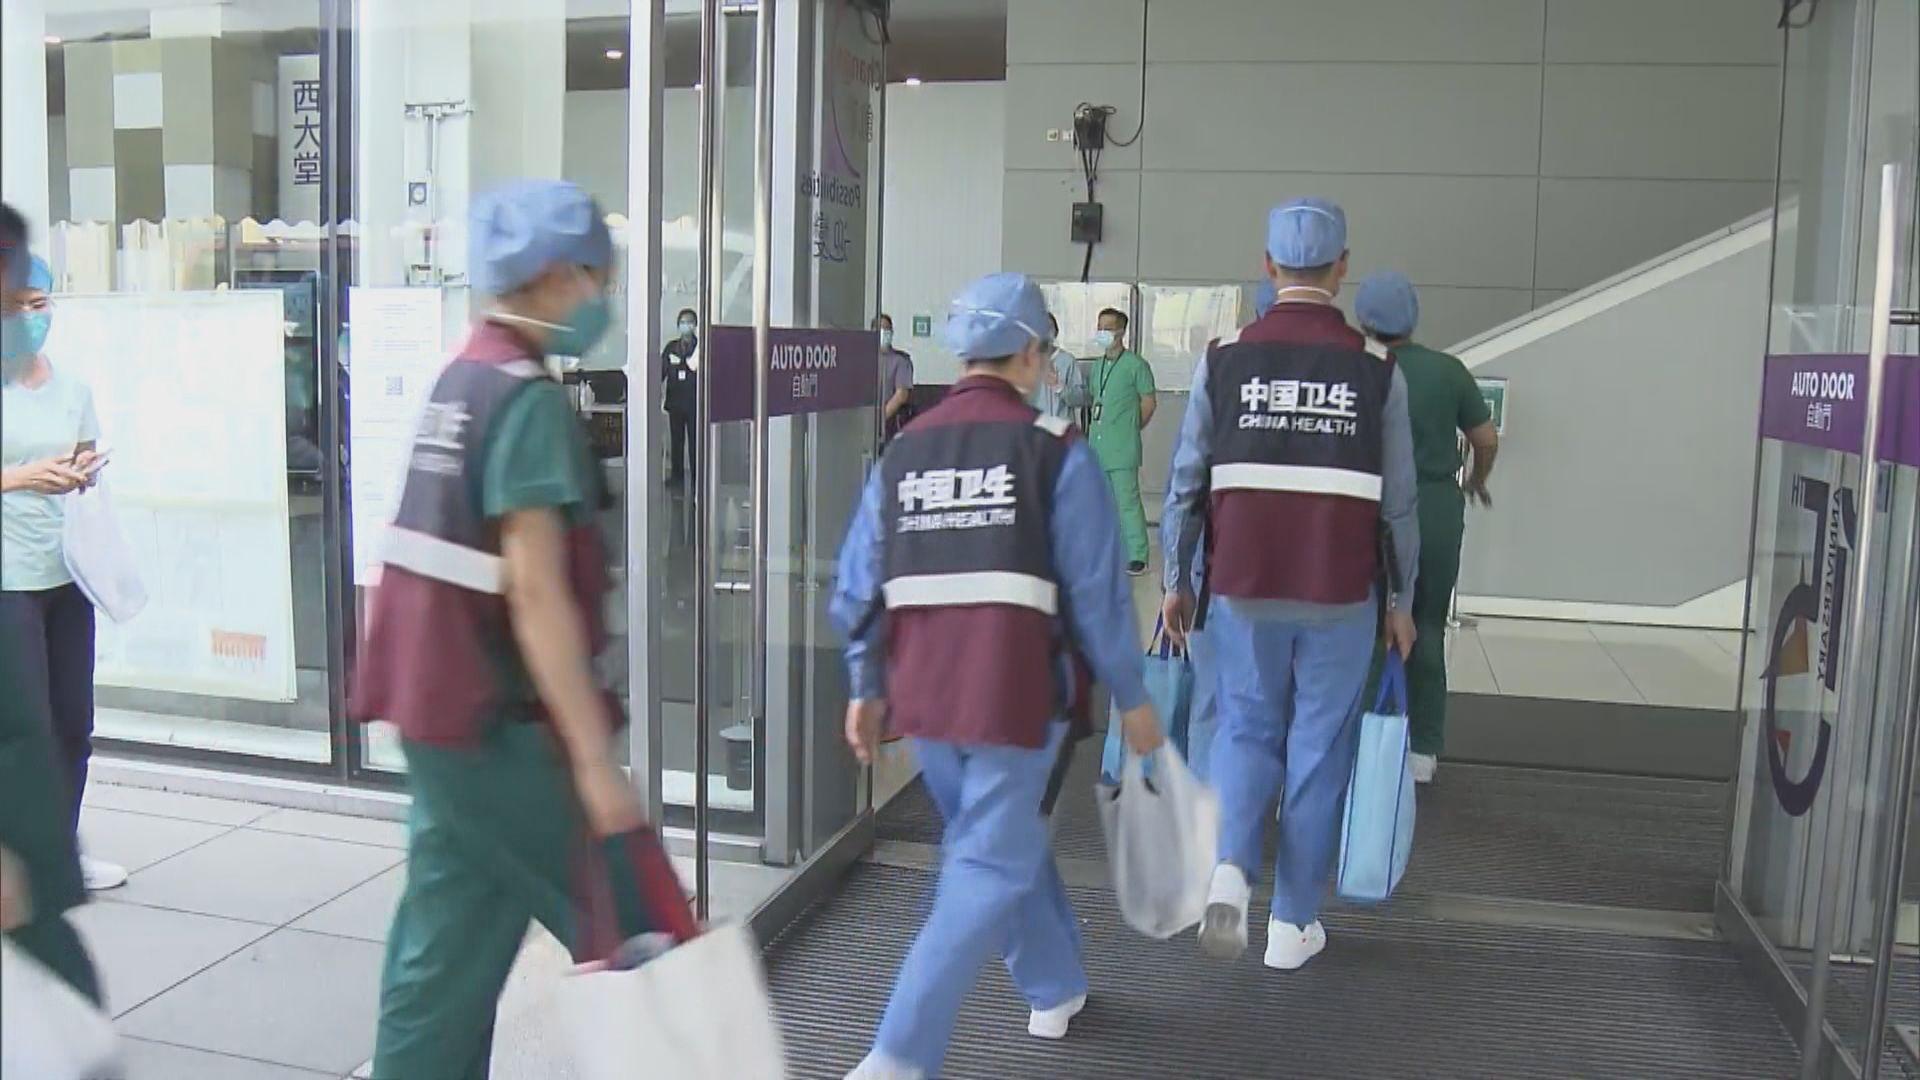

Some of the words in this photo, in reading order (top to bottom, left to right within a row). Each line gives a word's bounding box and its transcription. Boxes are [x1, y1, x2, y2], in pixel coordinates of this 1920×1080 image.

[293, 80, 321, 186] 西大堂
[771, 344, 803, 369] AUTO
[805, 344, 837, 369] DOOR
[1240, 376, 1358, 417] 中国卫生
[1791, 371, 1819, 397] AUTO
[1820, 372, 1855, 400] DOOR
[1238, 413, 1290, 432] CHINA
[1291, 415, 1357, 436] HEALTH
[897, 463, 1017, 512] 中国卫生
